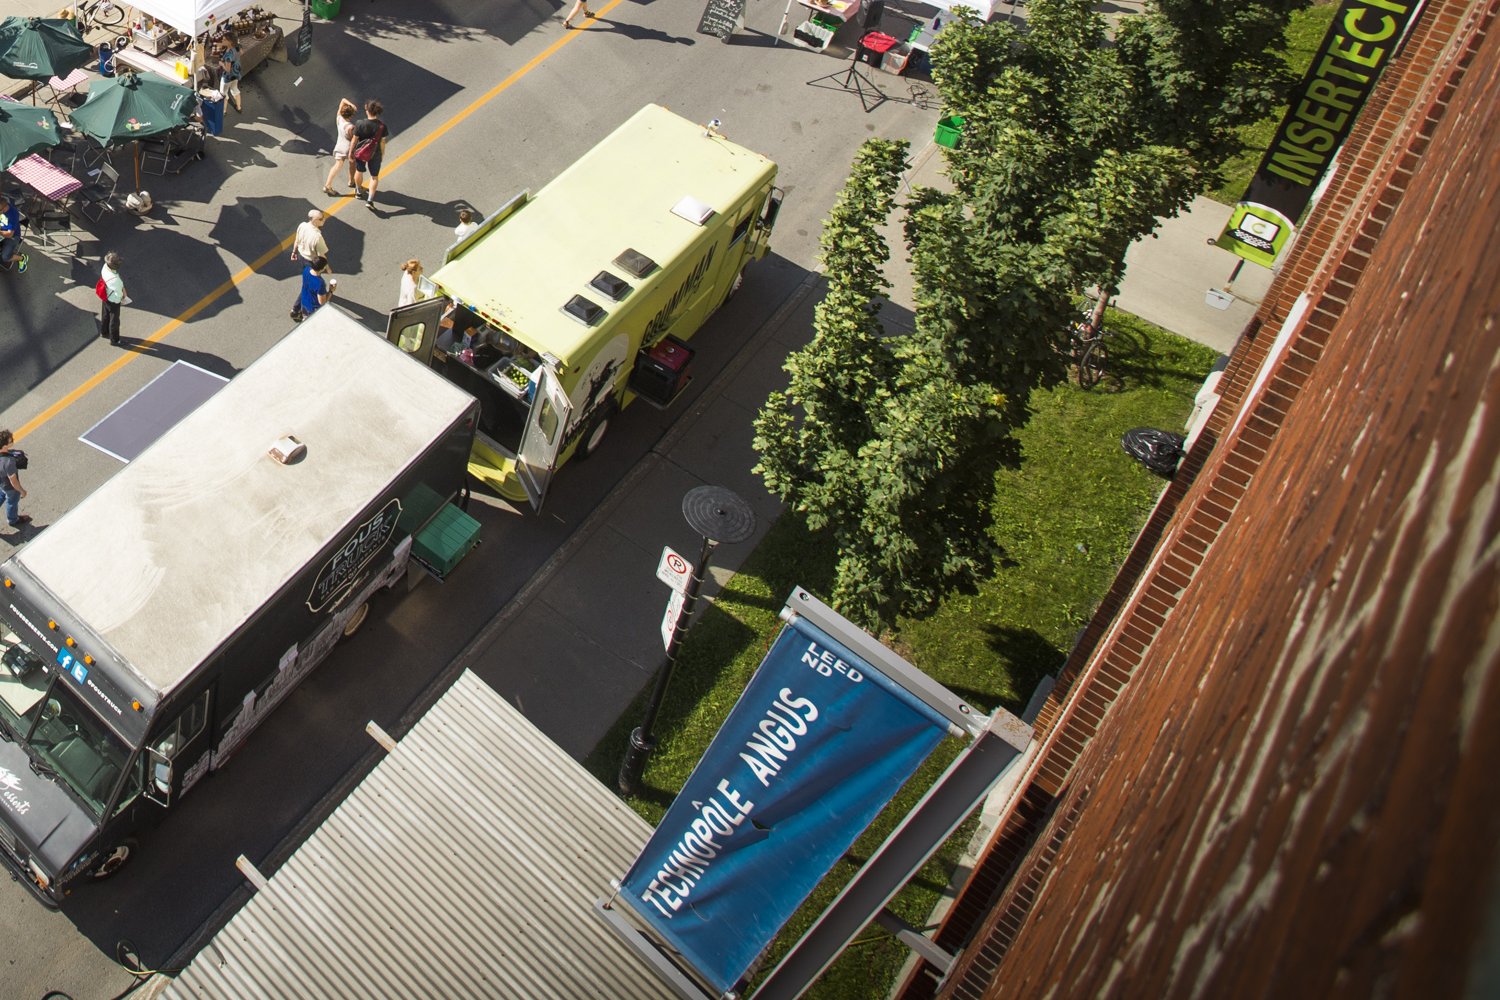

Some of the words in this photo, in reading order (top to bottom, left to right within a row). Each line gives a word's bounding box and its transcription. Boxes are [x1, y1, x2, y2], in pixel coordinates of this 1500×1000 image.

[331, 511, 385, 571] FOUS
[800, 651, 834, 678] ND
[806, 641, 864, 684] LEED
[641, 778, 755, 920] TECHNOPÔLE
[738, 686, 820, 788] ANGUS
